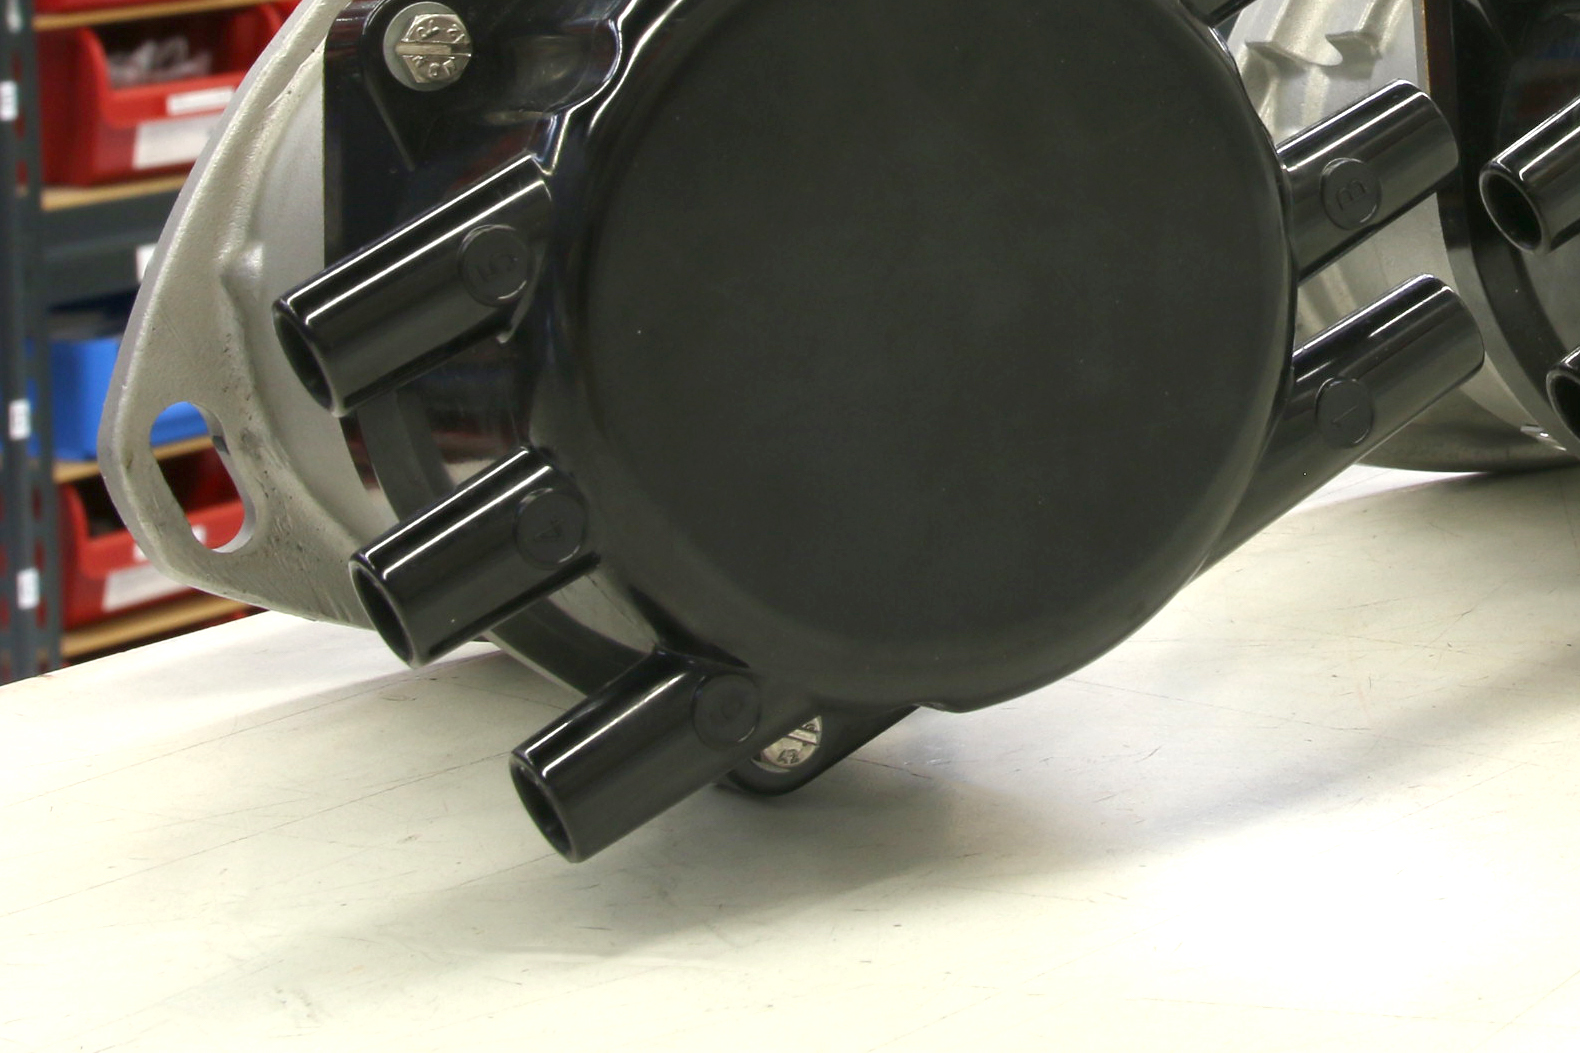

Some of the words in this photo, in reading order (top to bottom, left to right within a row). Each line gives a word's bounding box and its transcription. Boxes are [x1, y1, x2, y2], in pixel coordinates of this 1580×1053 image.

[1336, 178, 1368, 211] 3
[477, 252, 517, 283] 5
[1330, 403, 1361, 428] 1
[533, 515, 565, 543] 4
